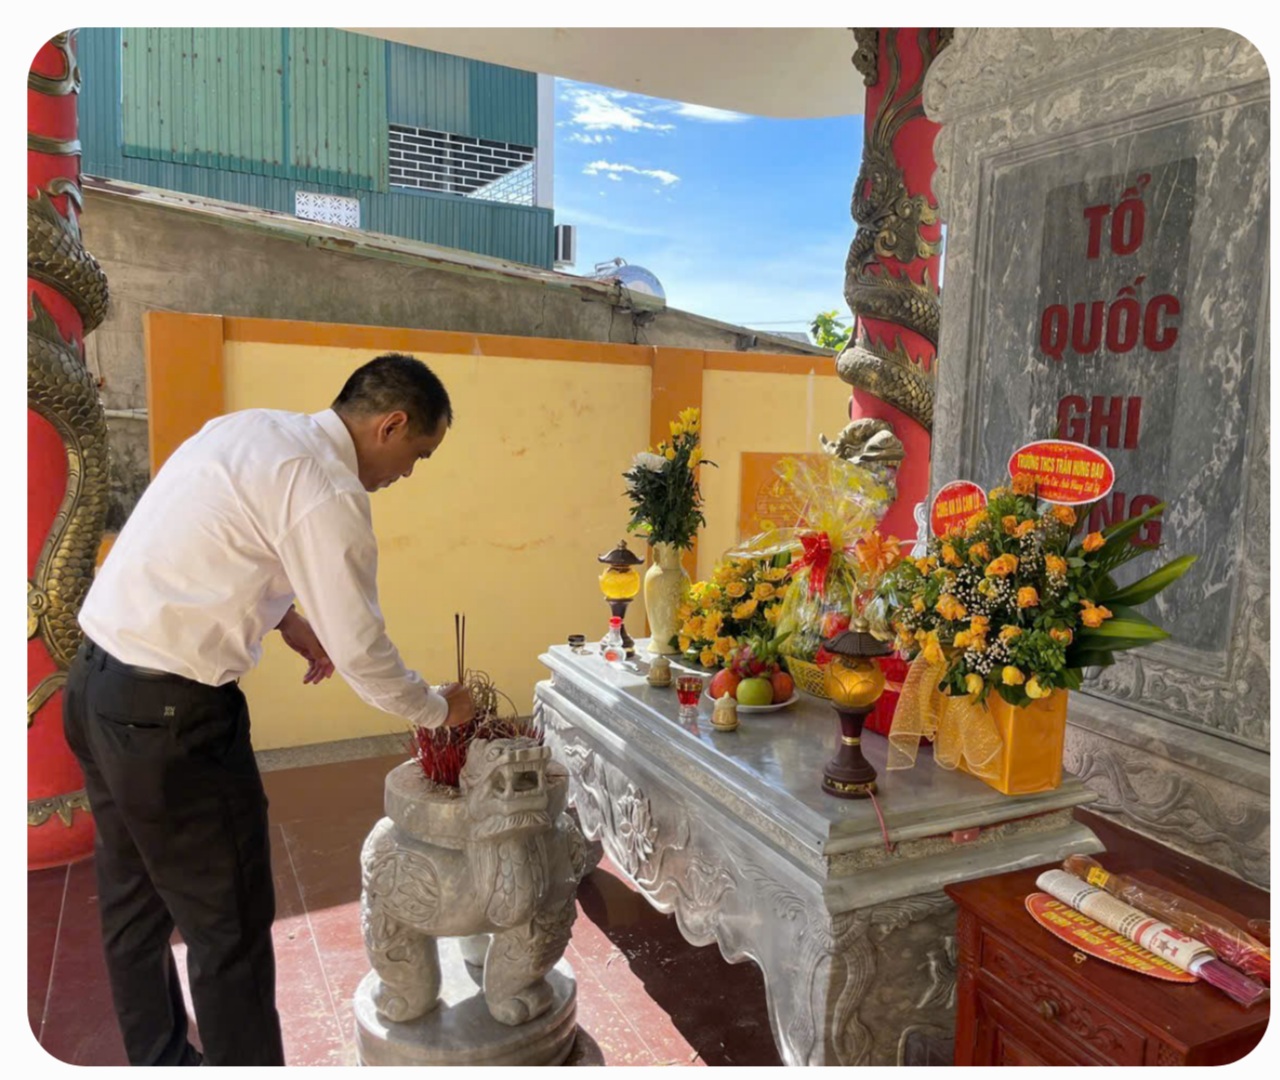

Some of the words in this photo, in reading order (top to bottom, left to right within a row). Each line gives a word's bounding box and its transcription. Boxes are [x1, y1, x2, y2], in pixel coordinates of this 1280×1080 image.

[1084, 173, 1152, 260] TỔ
[1040, 273, 1181, 362] QUỐC
[1057, 394, 1143, 450] GHI
